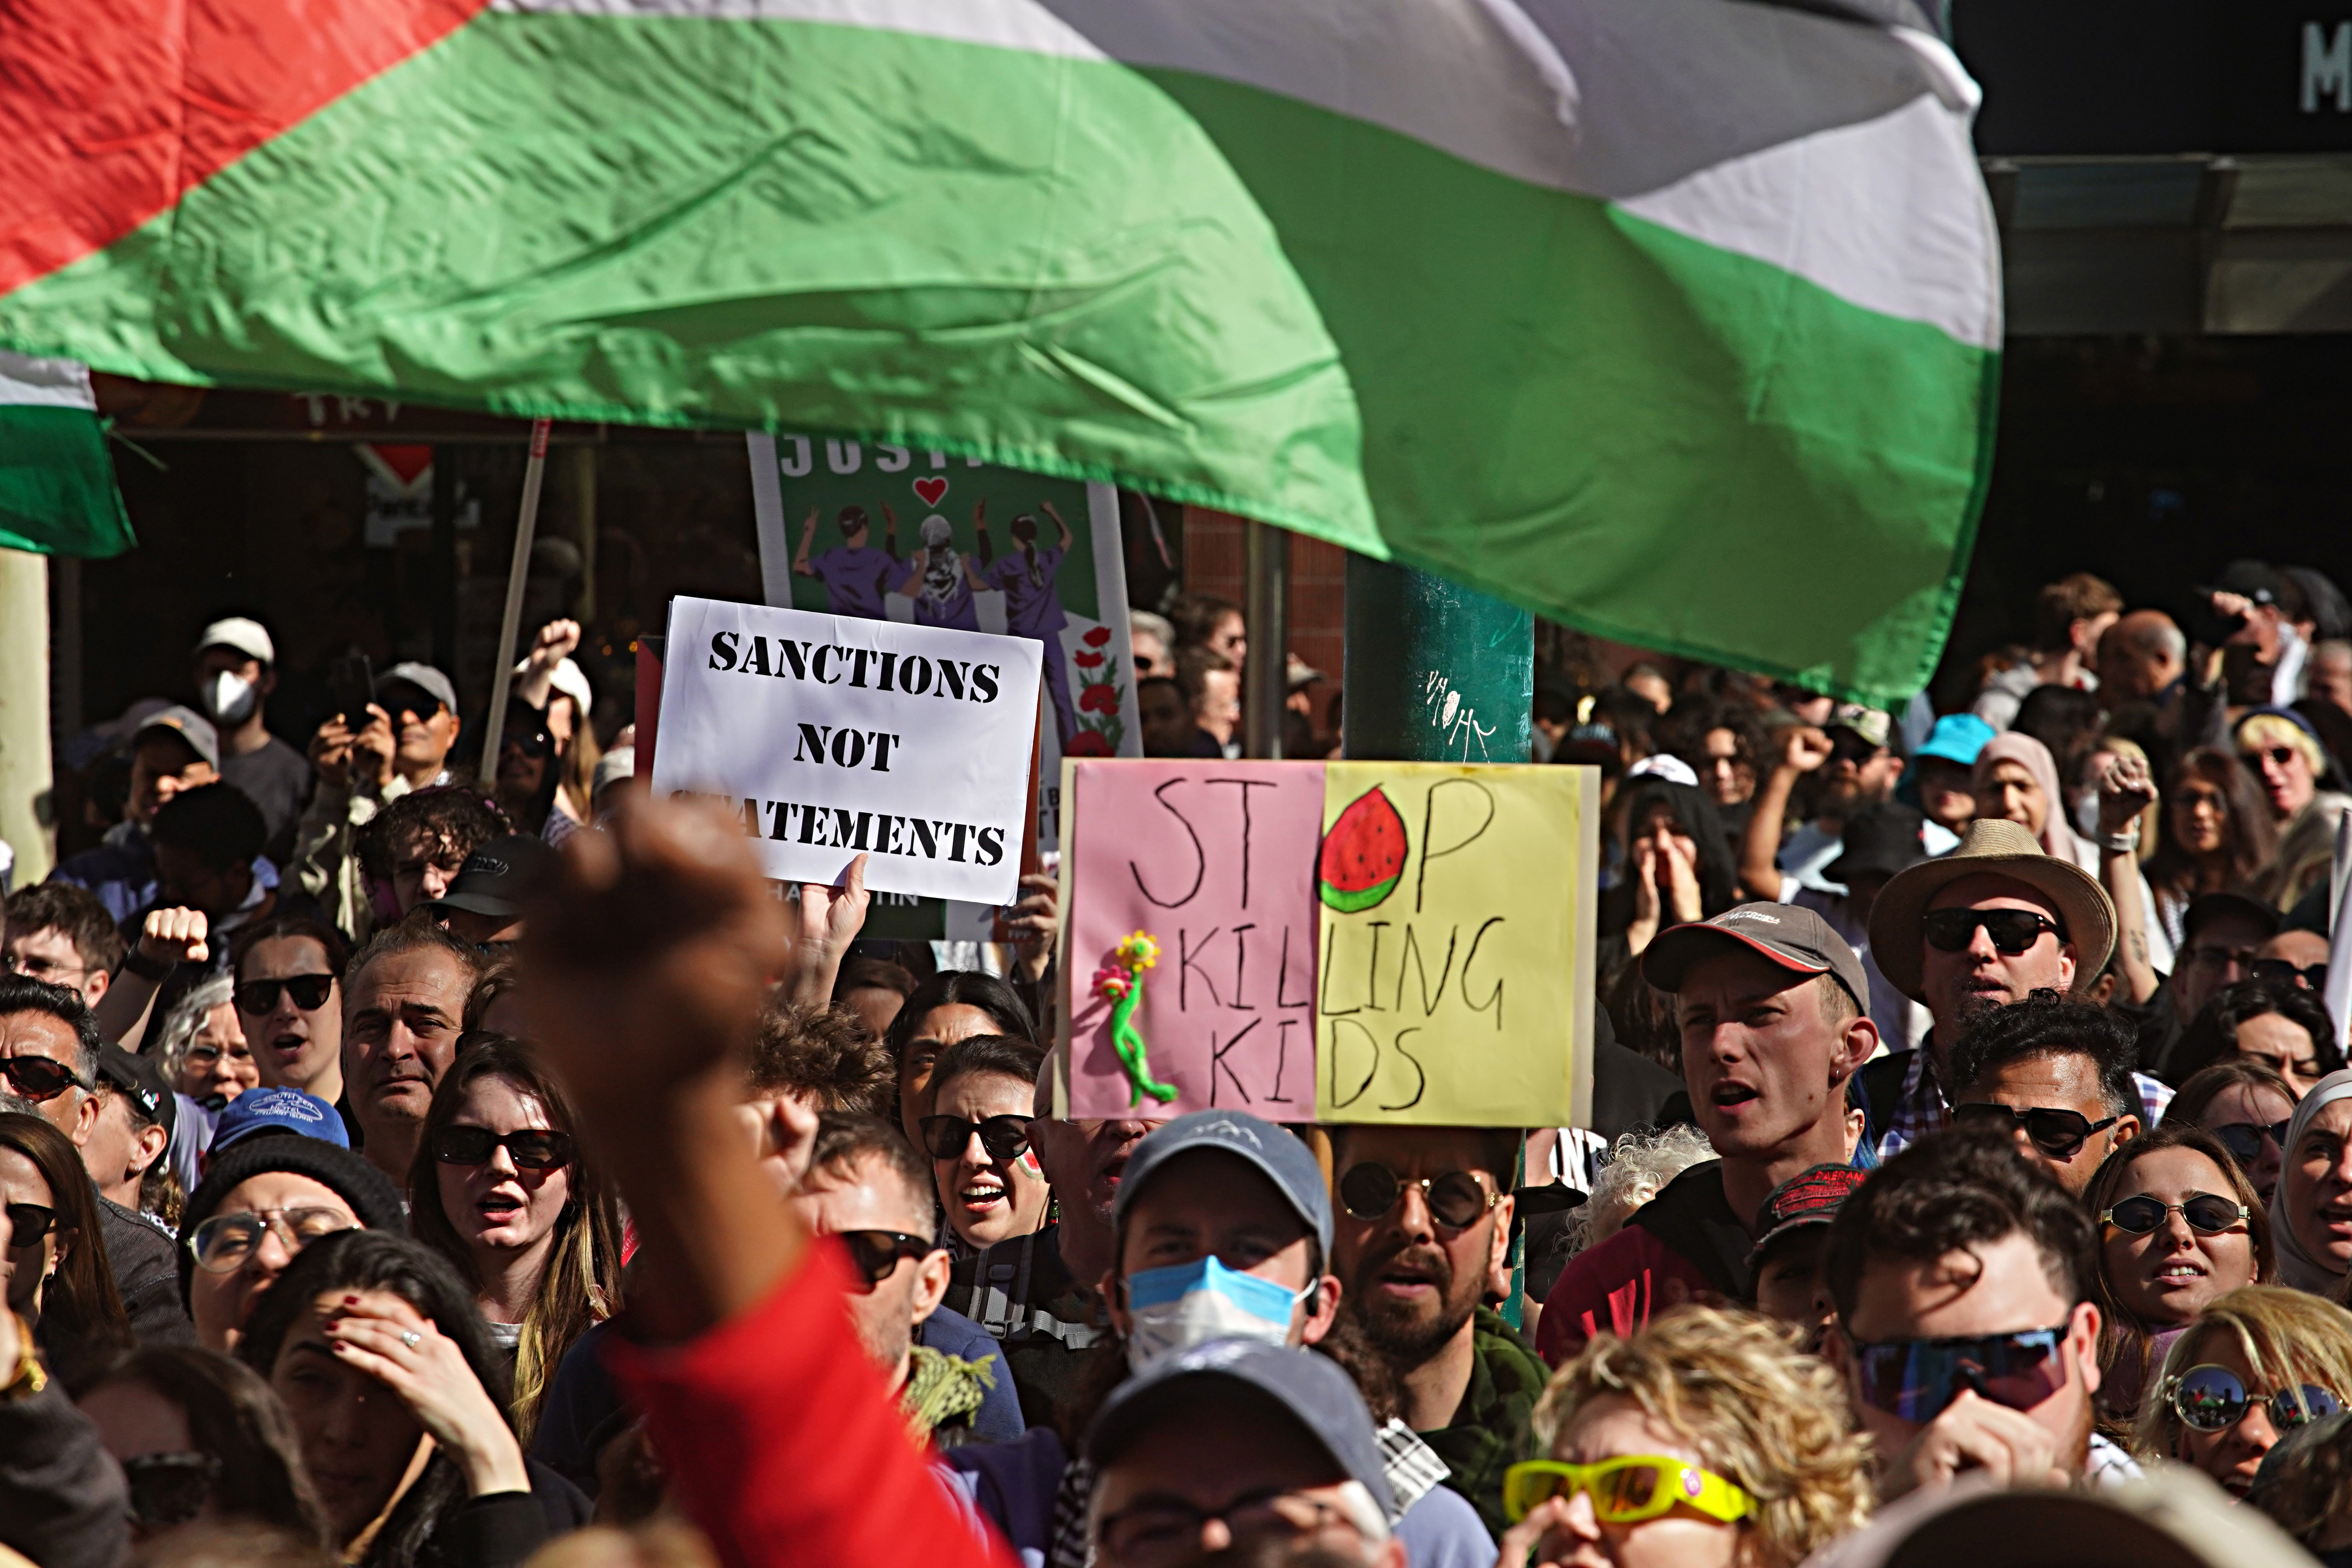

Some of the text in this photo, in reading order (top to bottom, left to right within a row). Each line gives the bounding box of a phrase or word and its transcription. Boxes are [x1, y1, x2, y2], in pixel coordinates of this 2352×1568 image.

[709, 631, 1000, 703] SANCTIONS
[793, 723, 900, 772] NOT
[668, 789, 1005, 867] ATEMENTS
[1129, 778, 1495, 914] STOP
[1179, 916, 1506, 1031] KILLING
[1210, 1017, 1425, 1111] KIDS
[270, 1104, 299, 1112] HOTEL
[289, 1112, 313, 1123] ISLAND
